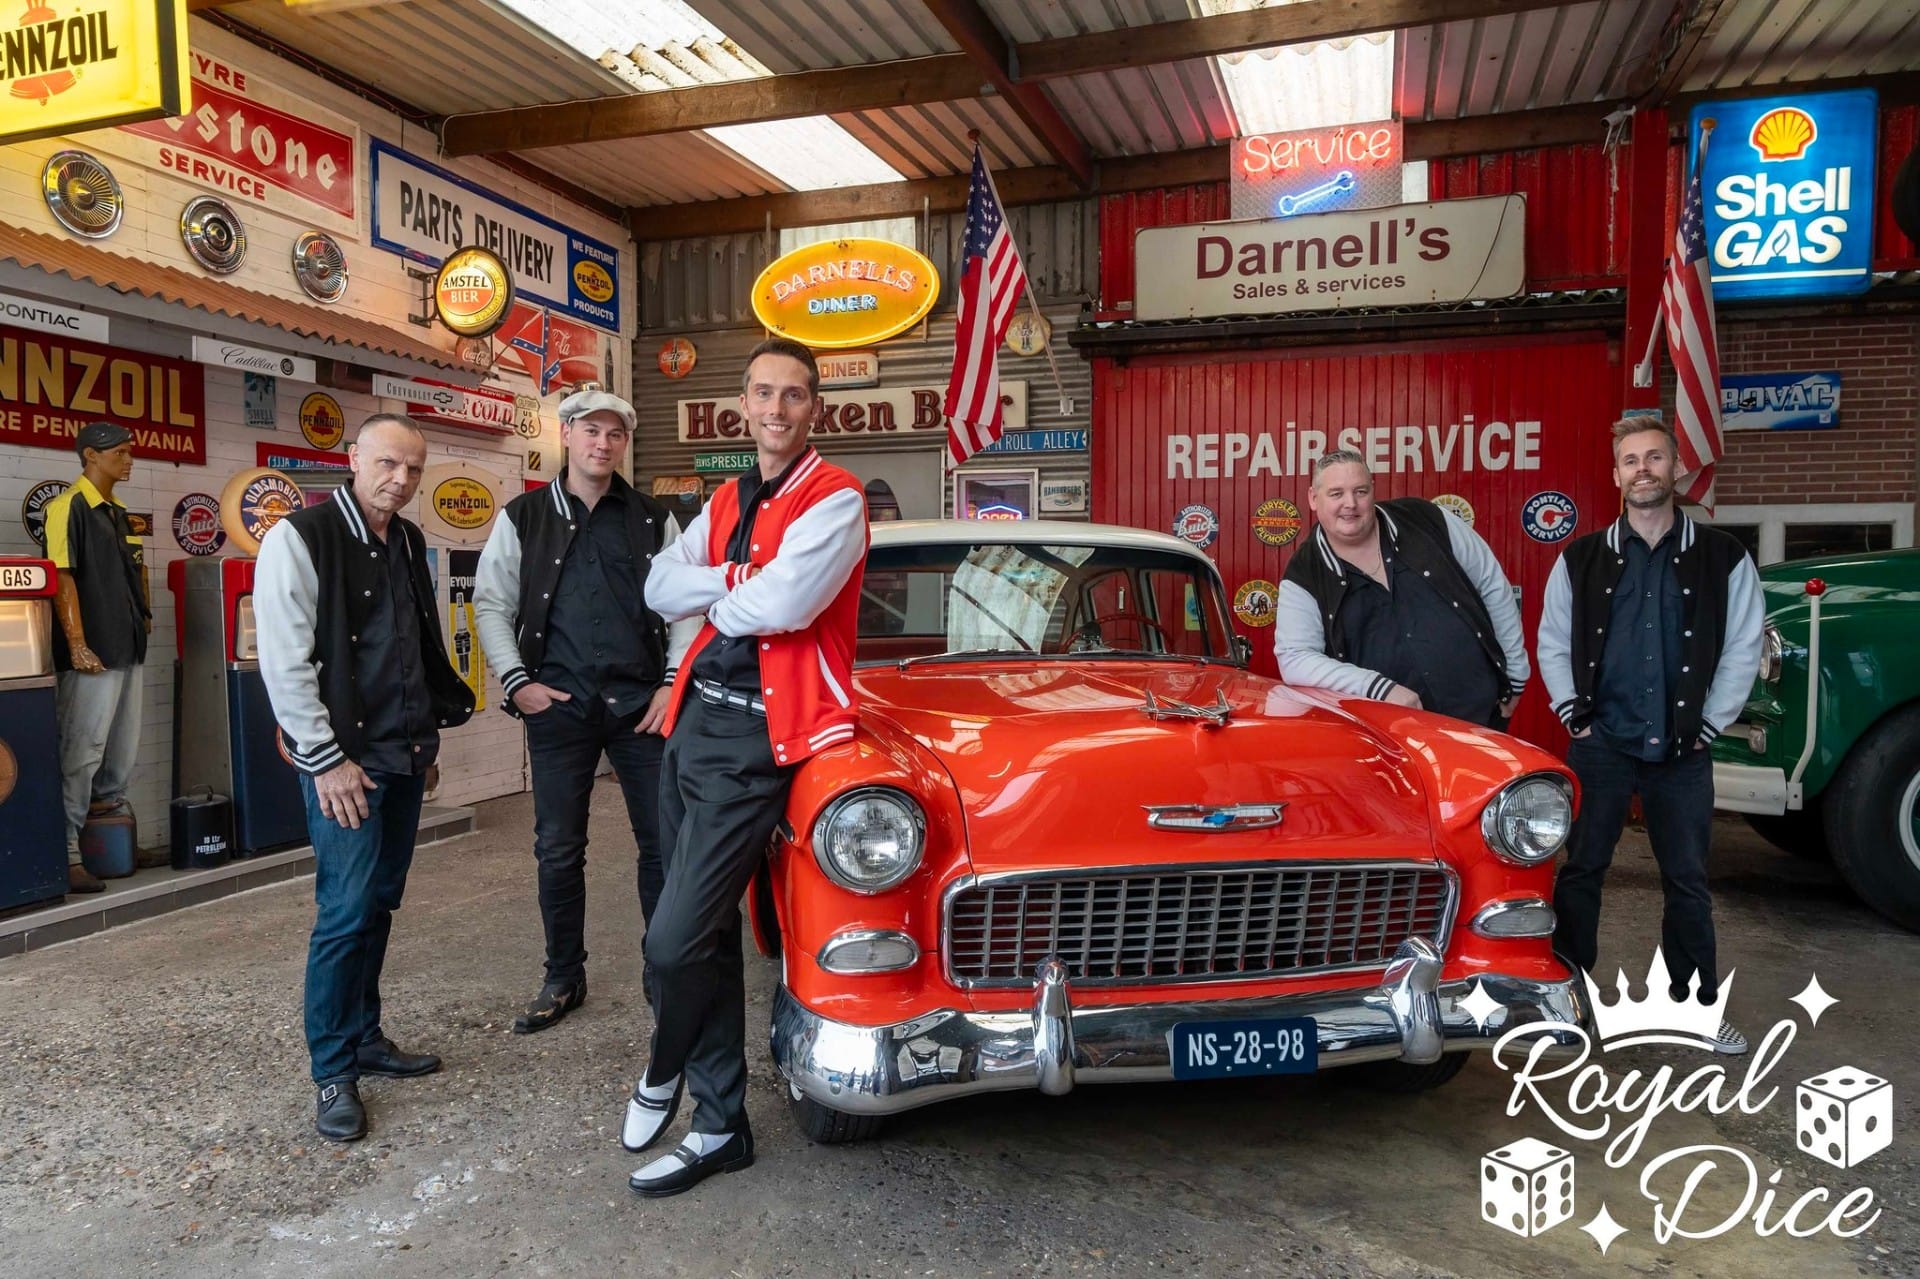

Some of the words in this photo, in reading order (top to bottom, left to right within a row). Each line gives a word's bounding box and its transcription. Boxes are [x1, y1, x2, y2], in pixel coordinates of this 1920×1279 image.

[189, 51, 246, 92] YRE
[164, 103, 338, 191] stone
[1242, 127, 1392, 174] Service
[160, 148, 267, 201] SERVICE
[1714, 166, 1852, 221] Shell
[400, 180, 463, 249] PARTS
[474, 213, 554, 284] DELIVERY
[1713, 215, 1849, 269] GAS
[572, 239, 584, 252] WE
[585, 245, 615, 266] FEATURE
[1197, 217, 1450, 280] Darnell's
[443, 275, 488, 288] AMSTEL
[576, 272, 611, 290] PENNZOIL
[772, 260, 916, 300] DARNELLS
[1232, 283, 1288, 300] Sales
[1295, 279, 1310, 295] &
[1316, 274, 1406, 294] services
[450, 290, 479, 304] BIER
[808, 293, 877, 315] DINER
[573, 298, 615, 322] PRODUCTS
[220, 346, 280, 371] Cadillac
[820, 359, 868, 379] DINER
[387, 382, 431, 400] CHEVROLET
[1720, 384, 1834, 413] BOVAG
[303, 414, 342, 429] PENNZOIL
[471, 400, 512, 424] COLD
[686, 396, 897, 440] Heken
[521, 418, 535, 434] 66
[1006, 433, 1033, 450] ROLL
[1043, 431, 1078, 449] ALLEY
[696, 458, 711, 468] ELVIS
[711, 455, 755, 468] PRESLEY
[245, 475, 301, 508] OLDSMOBILE
[1044, 486, 1081, 497] HAMBURGERS
[182, 495, 219, 512] AUTHORIZED
[440, 498, 489, 509] PENNZOIL
[1257, 500, 1297, 518] CHRYSLER
[1527, 495, 1572, 515] PONTIAC
[179, 511, 223, 537] Buick
[1177, 514, 1217, 537] Buick
[1256, 526, 1296, 543] PLYMOUTH
[1527, 521, 1572, 540] SERVICE
[180, 538, 220, 555] SERVICE
[3, 569, 32, 587] GAS
[1188, 1029, 1304, 1067] NS-28-98
